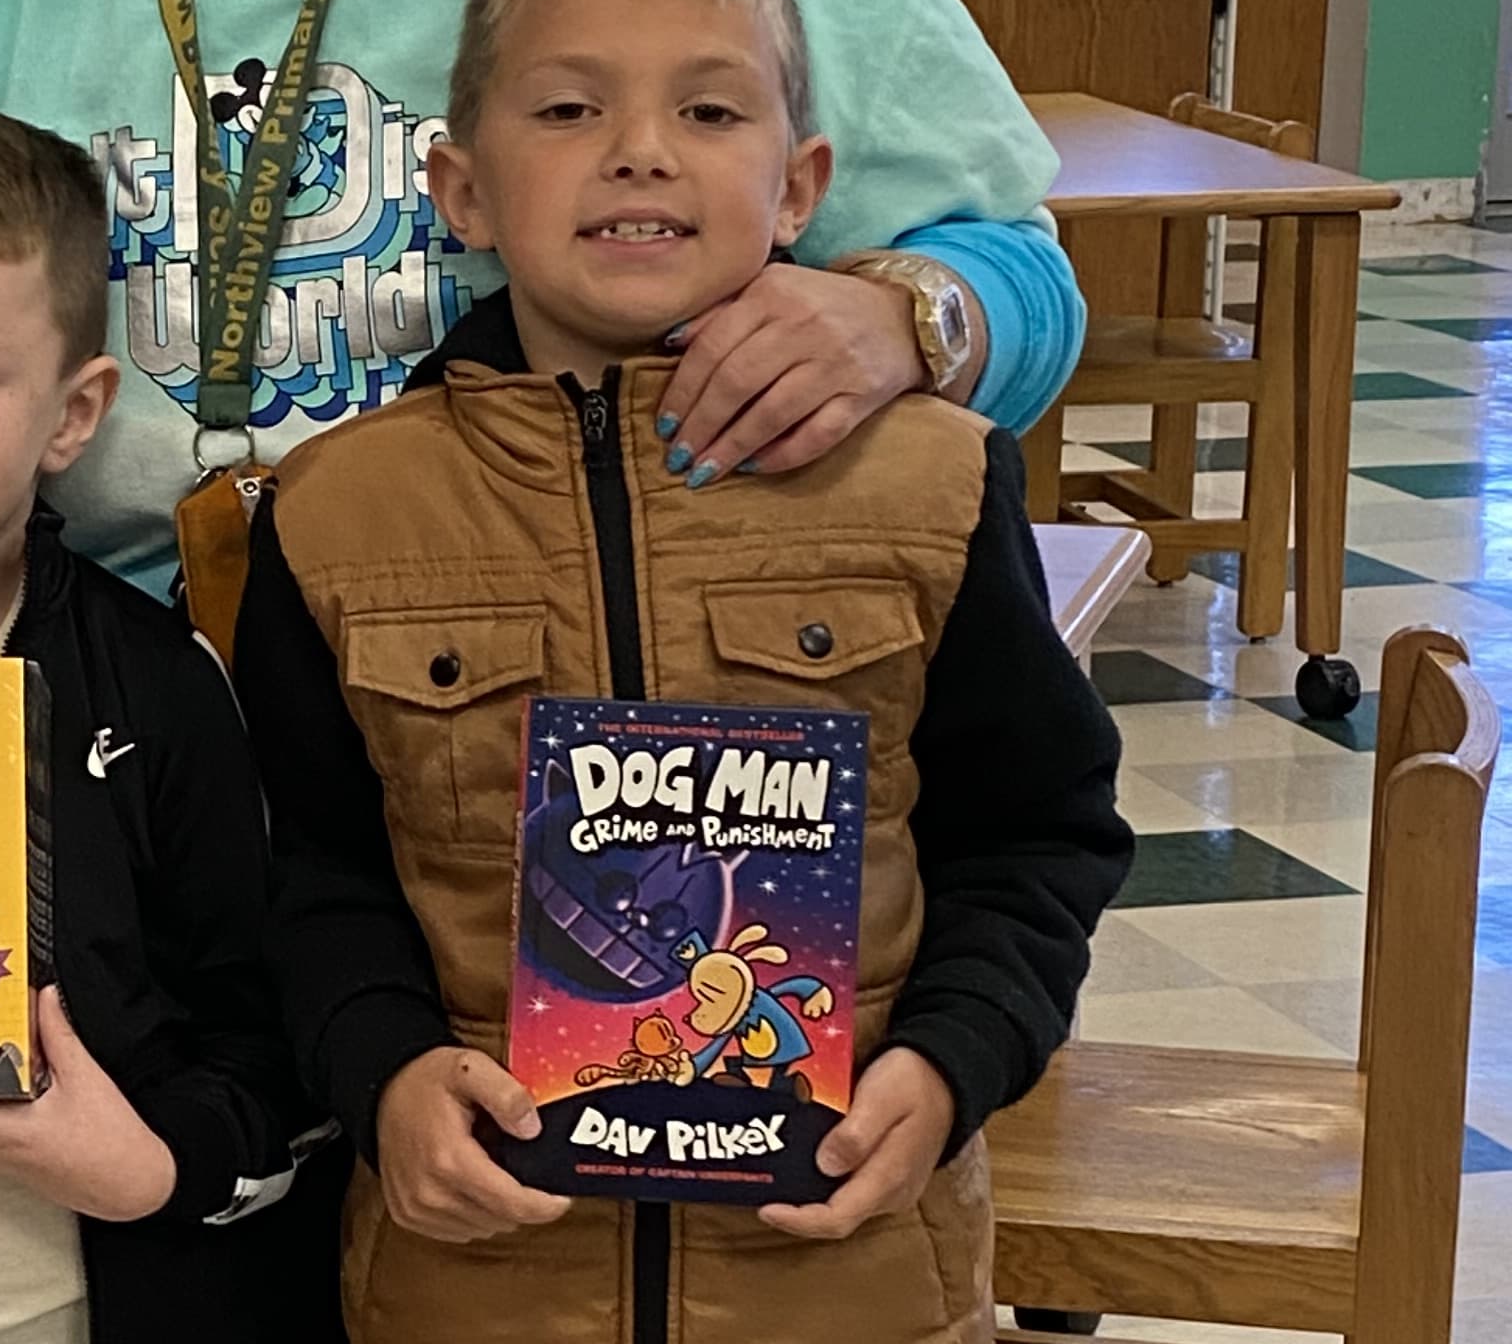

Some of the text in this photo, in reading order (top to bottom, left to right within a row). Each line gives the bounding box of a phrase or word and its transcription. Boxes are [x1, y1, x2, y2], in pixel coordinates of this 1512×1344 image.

[126, 250, 434, 375] World
[208, 158, 281, 381] Northview
[569, 744, 830, 821] DOG MAN
[569, 1106, 656, 1158] DAV
